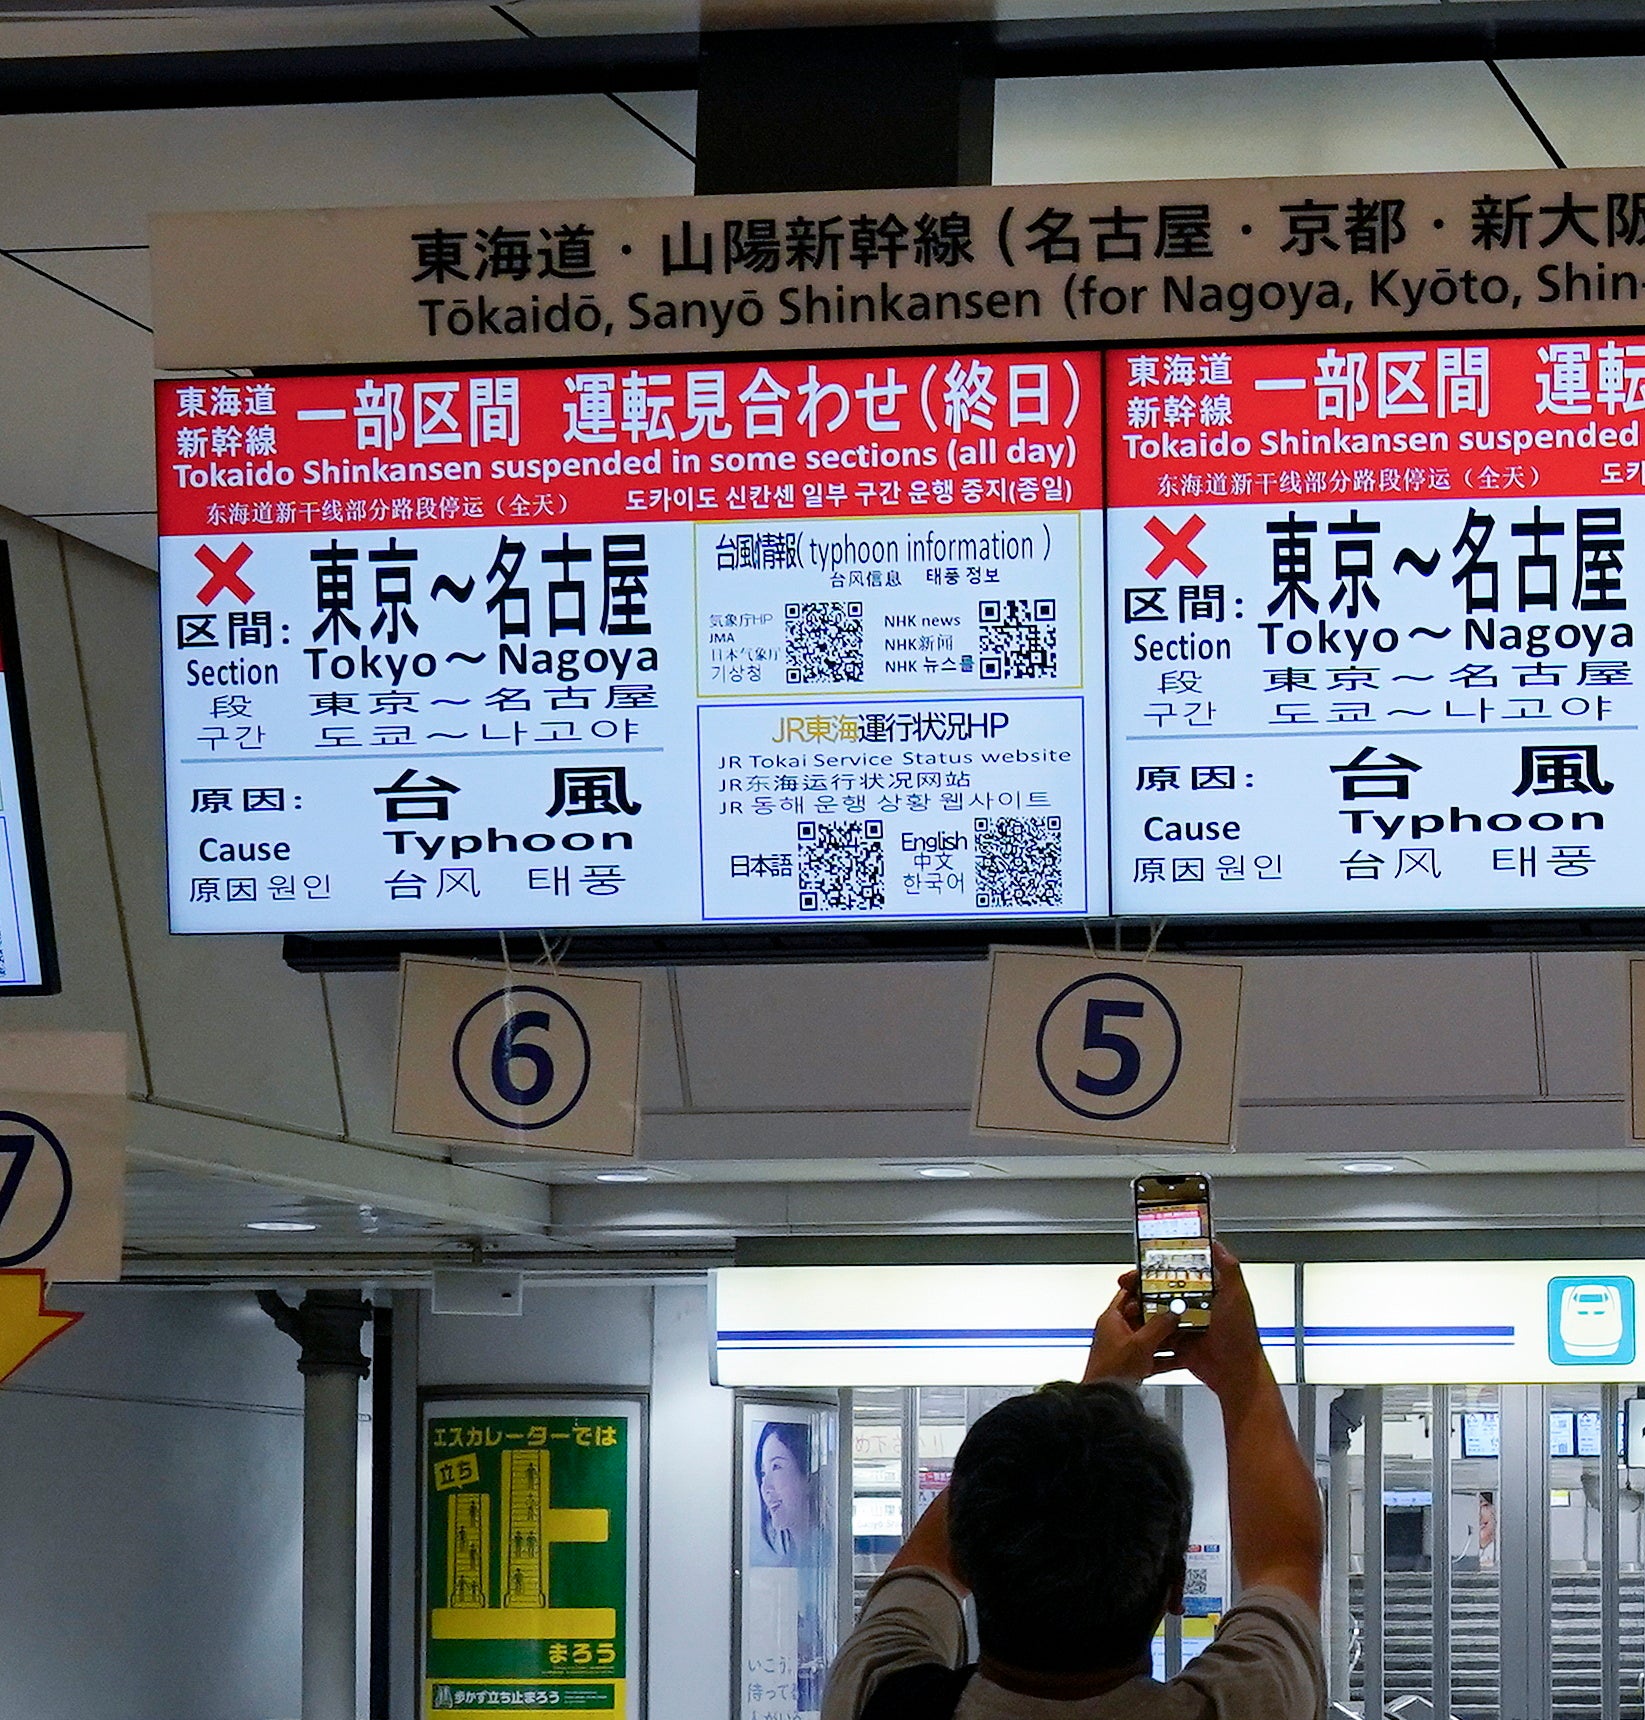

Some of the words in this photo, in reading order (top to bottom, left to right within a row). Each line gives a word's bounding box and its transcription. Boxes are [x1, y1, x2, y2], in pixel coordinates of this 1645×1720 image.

[418, 292, 615, 336] Tōkaidō,
[626, 287, 765, 334] Sanyō
[778, 281, 1042, 325] Shinkansen
[1062, 271, 1146, 322] (for
[1162, 274, 1356, 324] Nagoya,
[1368, 267, 1524, 312] Kyōto,
[174, 385, 279, 419] 東海道
[293, 376, 523, 453] 一部区間
[174, 422, 279, 459] 新幹線
[1131, 628, 1234, 666] Section
[1140, 810, 1243, 846] Cause
[1337, 804, 1608, 841] Typhoon
[488, 1008, 558, 1110] 6
[1072, 998, 1148, 1100] 5
[432, 1424, 618, 1448] エスカレーターでは
[547, 1642, 617, 1665] まろう
